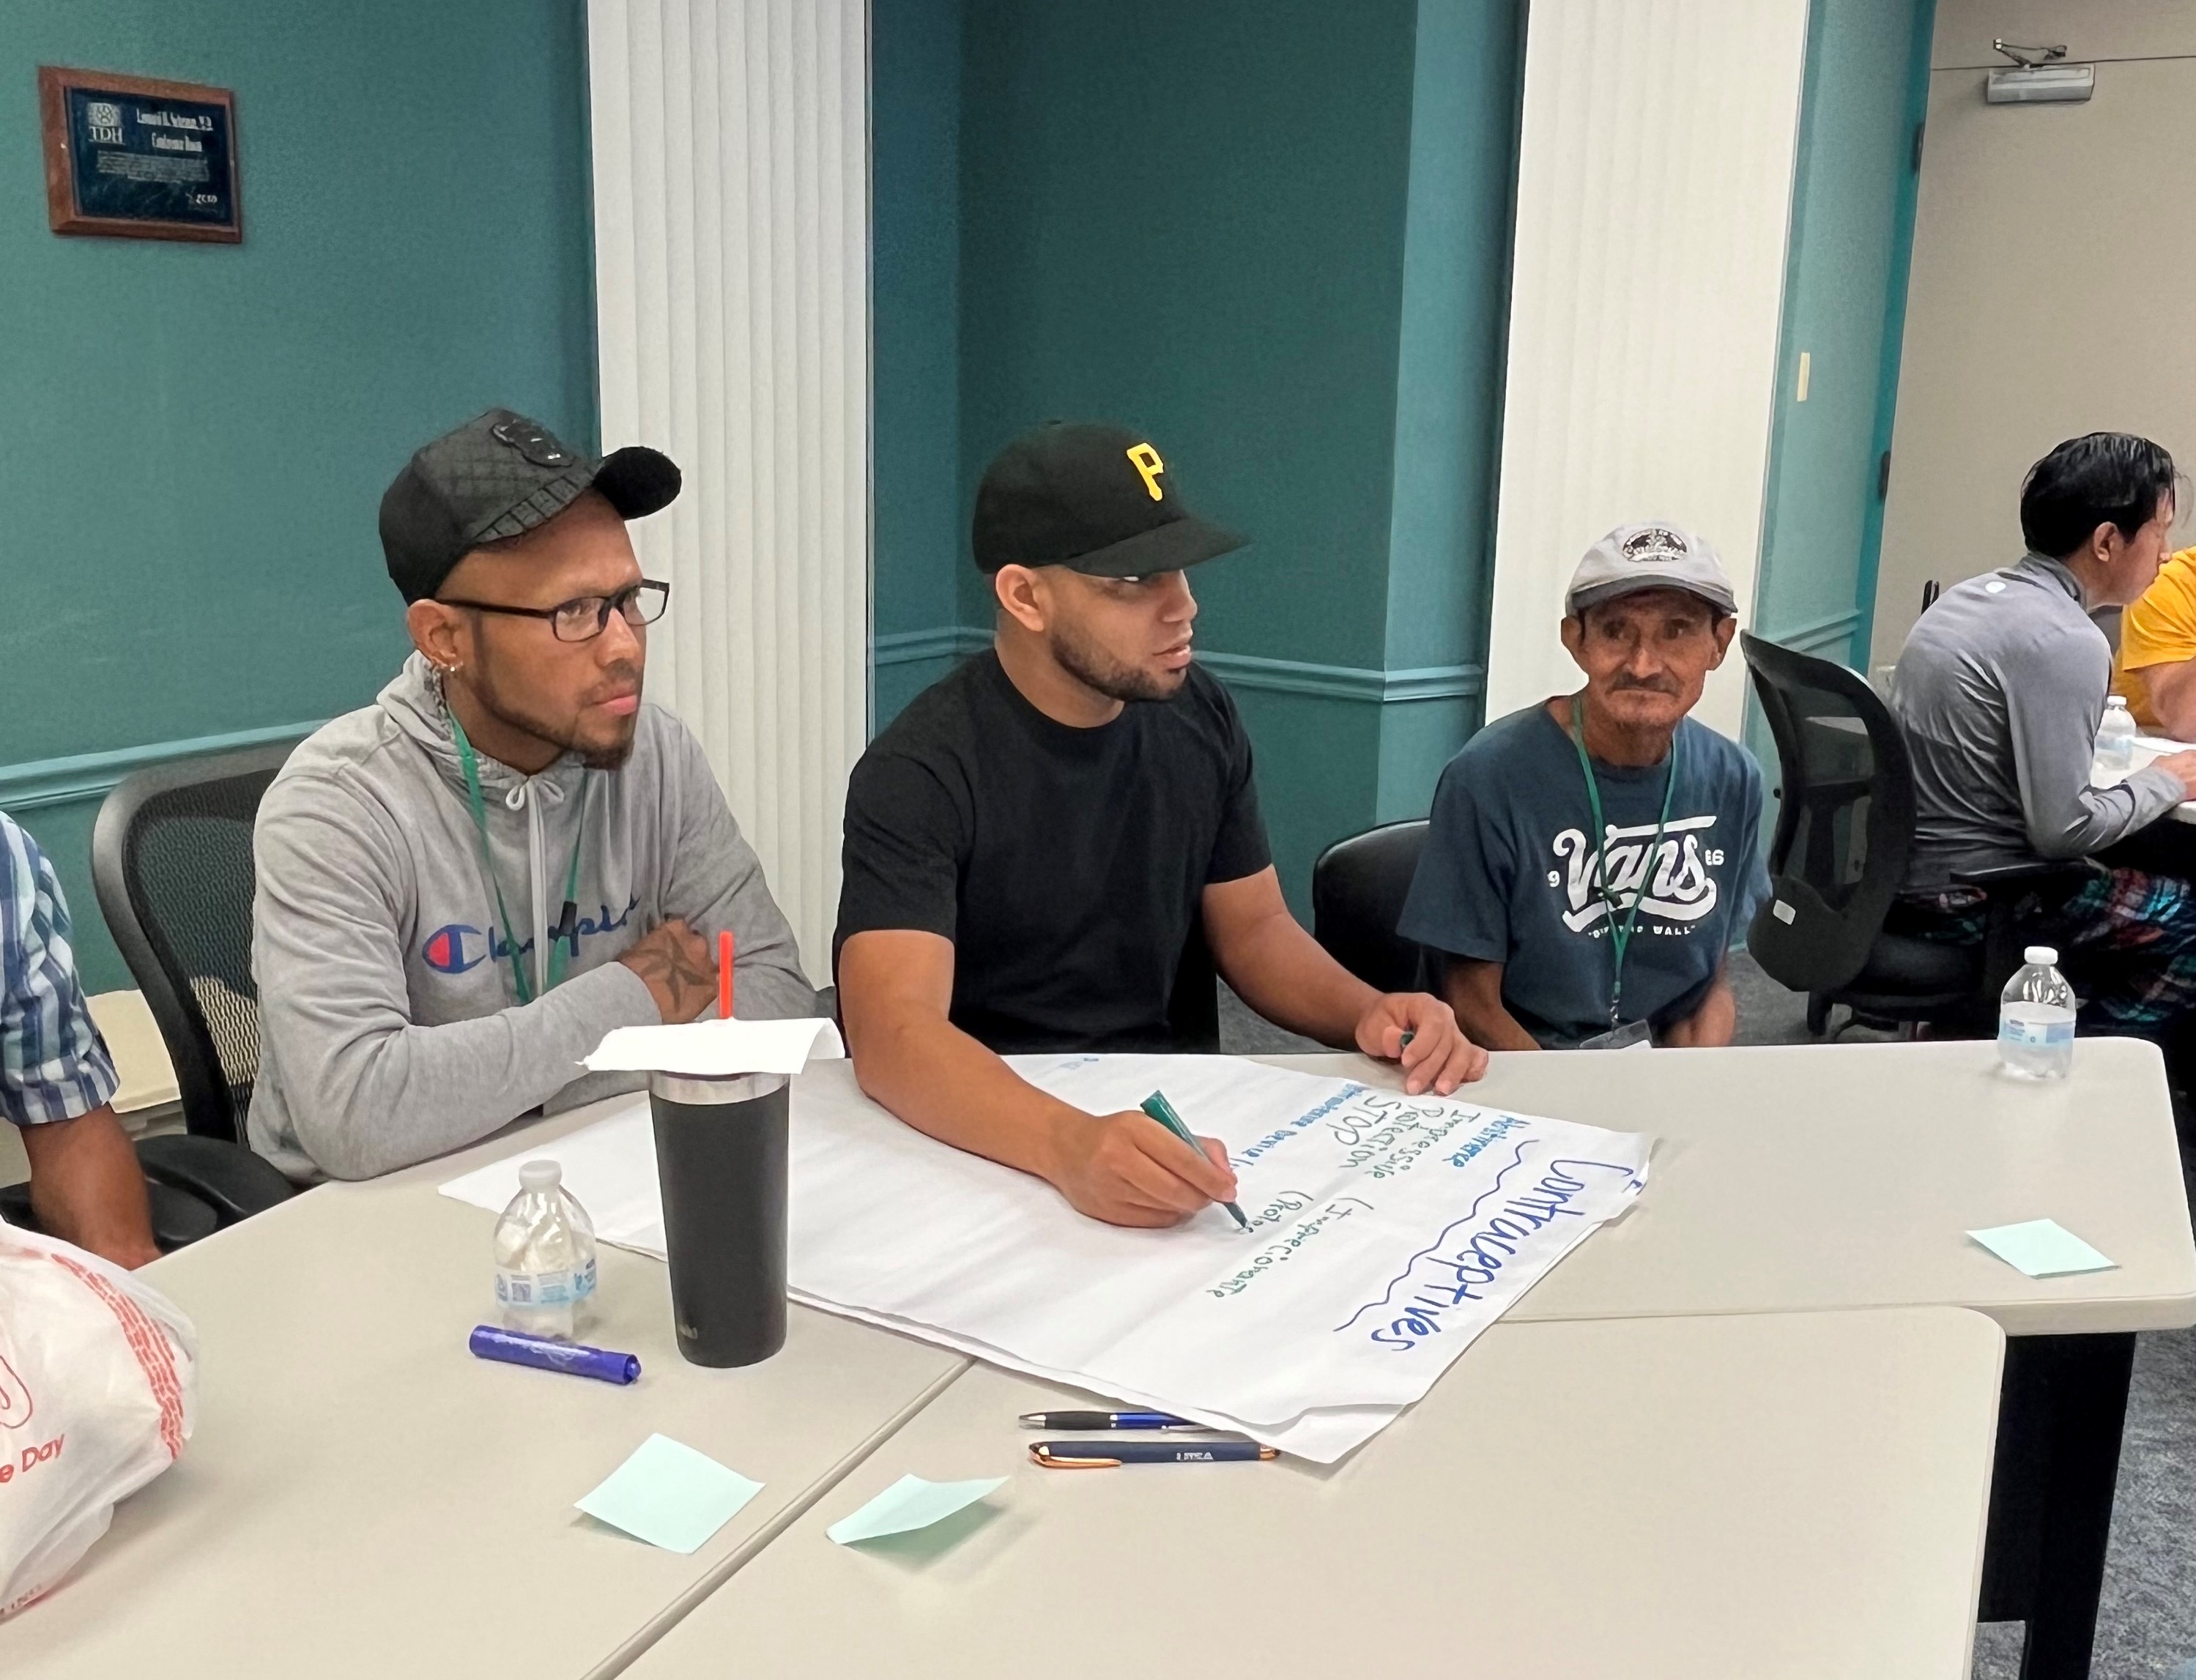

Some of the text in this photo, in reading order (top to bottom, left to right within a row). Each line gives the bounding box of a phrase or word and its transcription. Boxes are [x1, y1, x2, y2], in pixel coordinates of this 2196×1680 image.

[1126, 442, 1164, 502] P
[1553, 816, 1717, 932] Vans
[1325, 1096, 1401, 1145] STOP
[22, 1433, 64, 1473] Day
